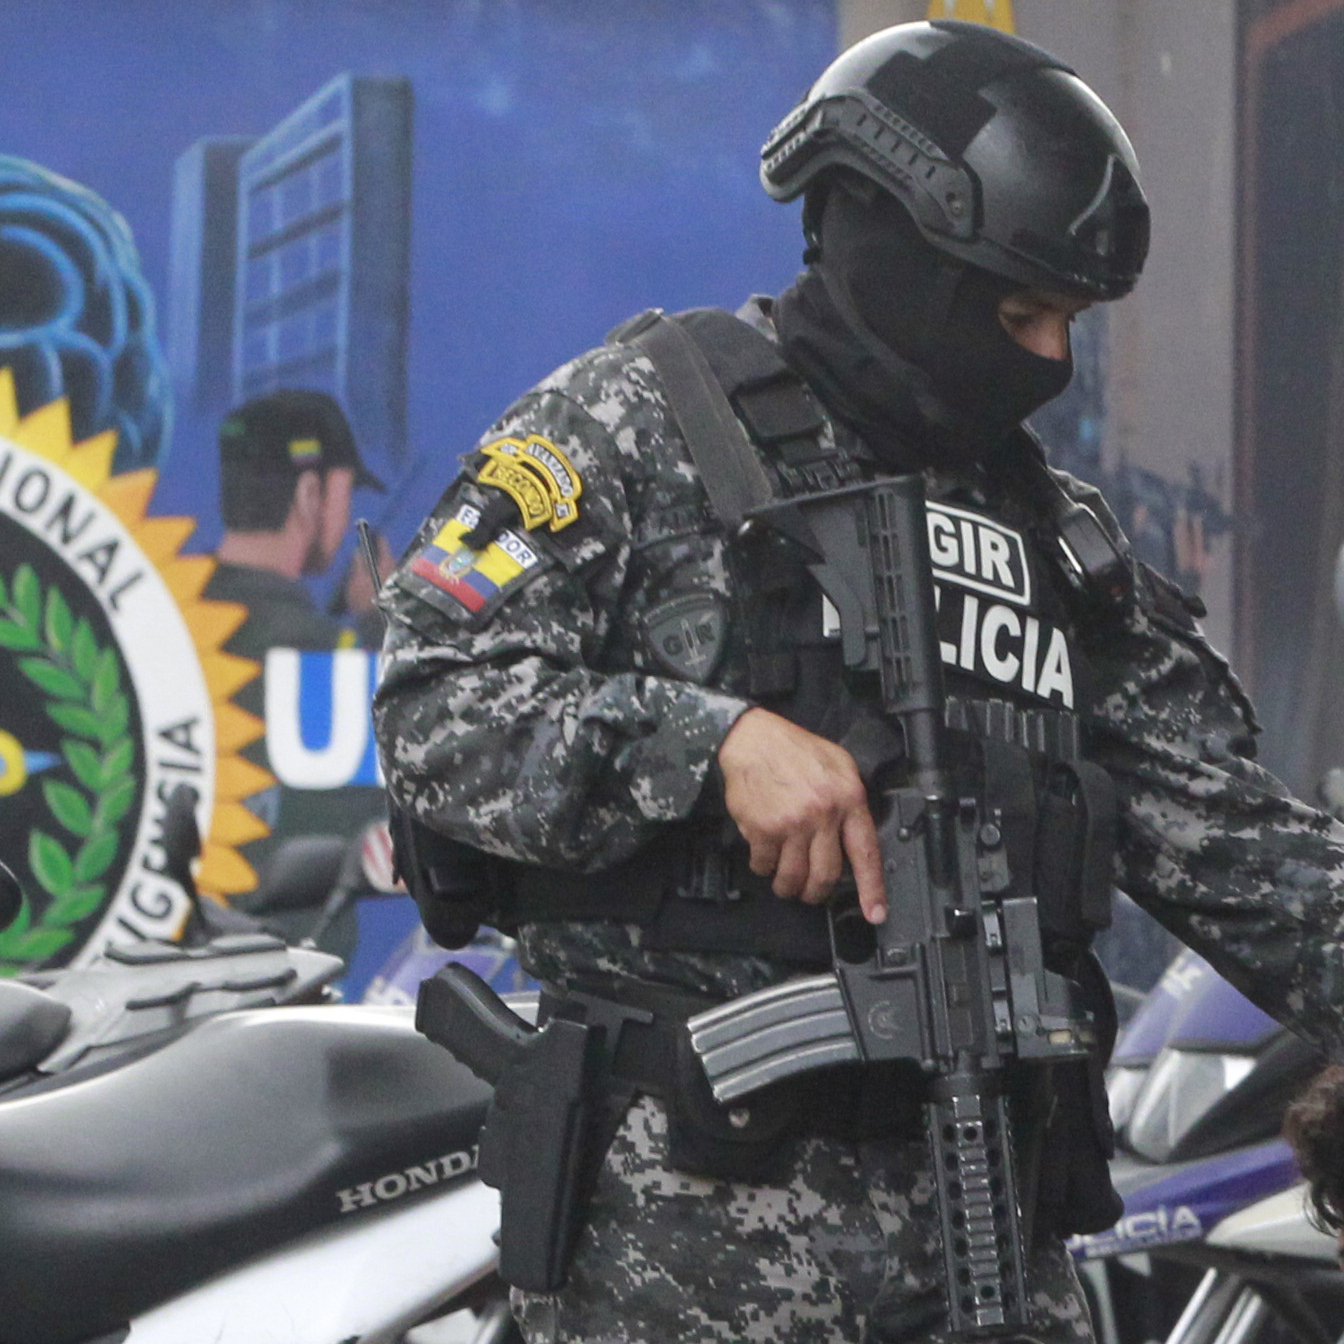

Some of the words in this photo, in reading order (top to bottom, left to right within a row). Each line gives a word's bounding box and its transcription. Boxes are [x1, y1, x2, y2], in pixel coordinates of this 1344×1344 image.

[926, 510, 1015, 589] GIR
[265, 647, 392, 790] U
[335, 1143, 480, 1213] HOND
